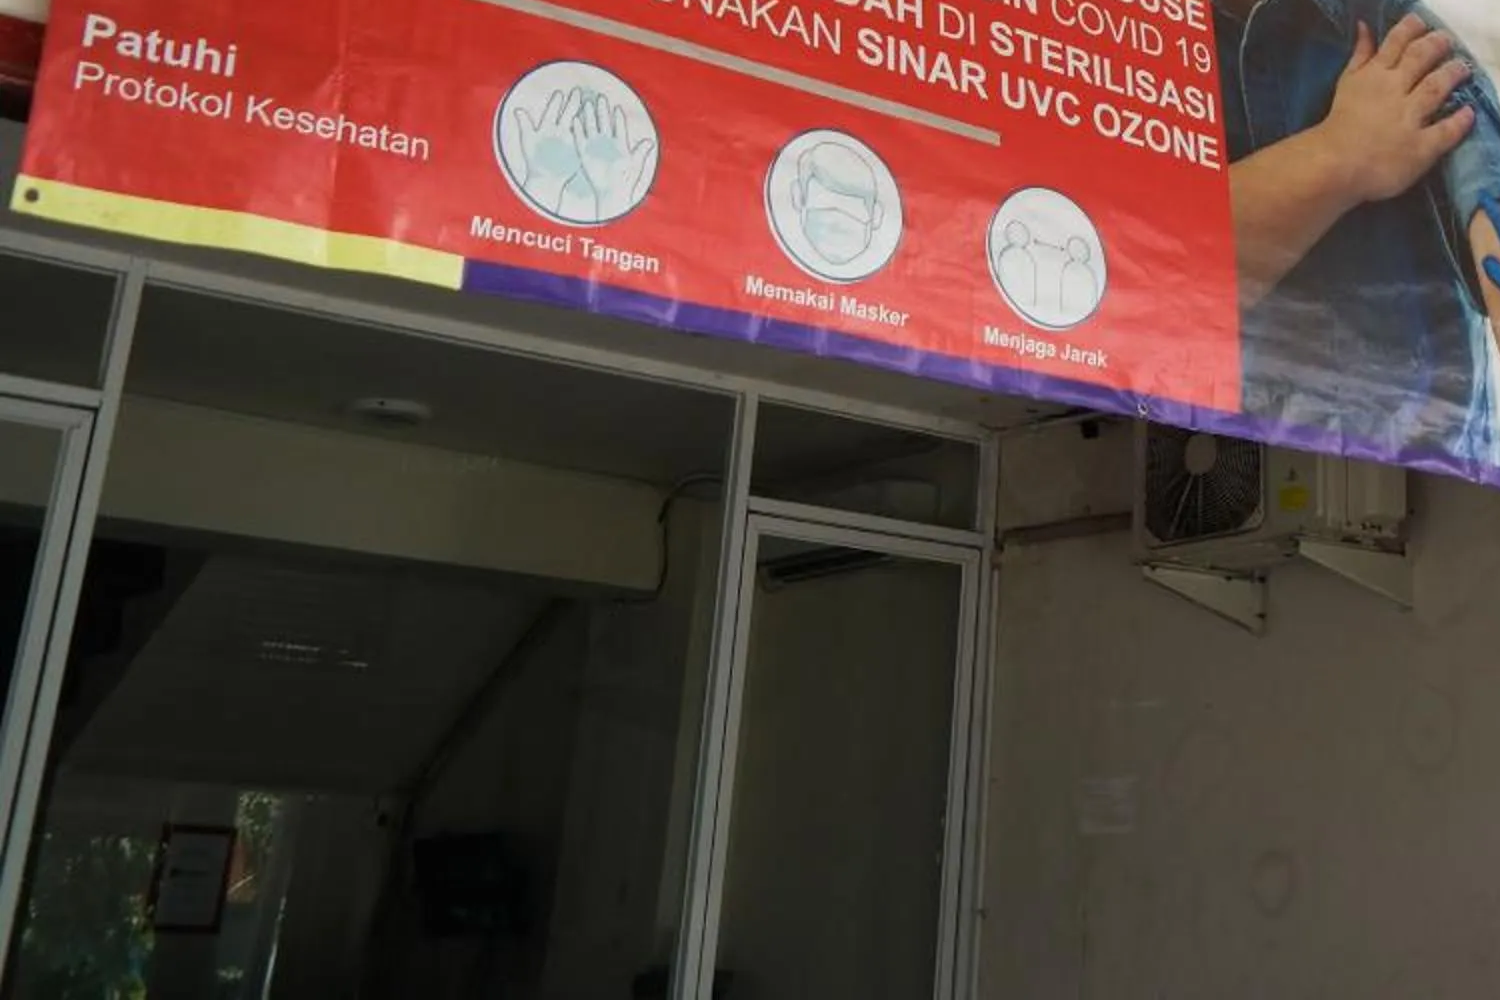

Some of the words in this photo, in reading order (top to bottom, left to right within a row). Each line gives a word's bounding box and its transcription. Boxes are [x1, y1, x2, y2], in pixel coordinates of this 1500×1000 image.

[82, 13, 237, 77] Patuhi
[939, 3, 976, 45] DI
[990, 21, 1216, 123] STERILISASI
[1176, 35, 1211, 73] 19
[74, 61, 231, 118] Protokol
[246, 96, 429, 161] Kesehatan
[857, 28, 988, 98] SINAR
[1002, 71, 1081, 126] UVC
[1094, 103, 1221, 169] OZONE
[470, 215, 572, 255] Mencuci
[579, 235, 659, 274] Tangan
[745, 275, 834, 310] Memakai
[841, 295, 909, 327] Masker
[984, 326, 1056, 360] Menjaga
[1060, 343, 1108, 367] Jarak
